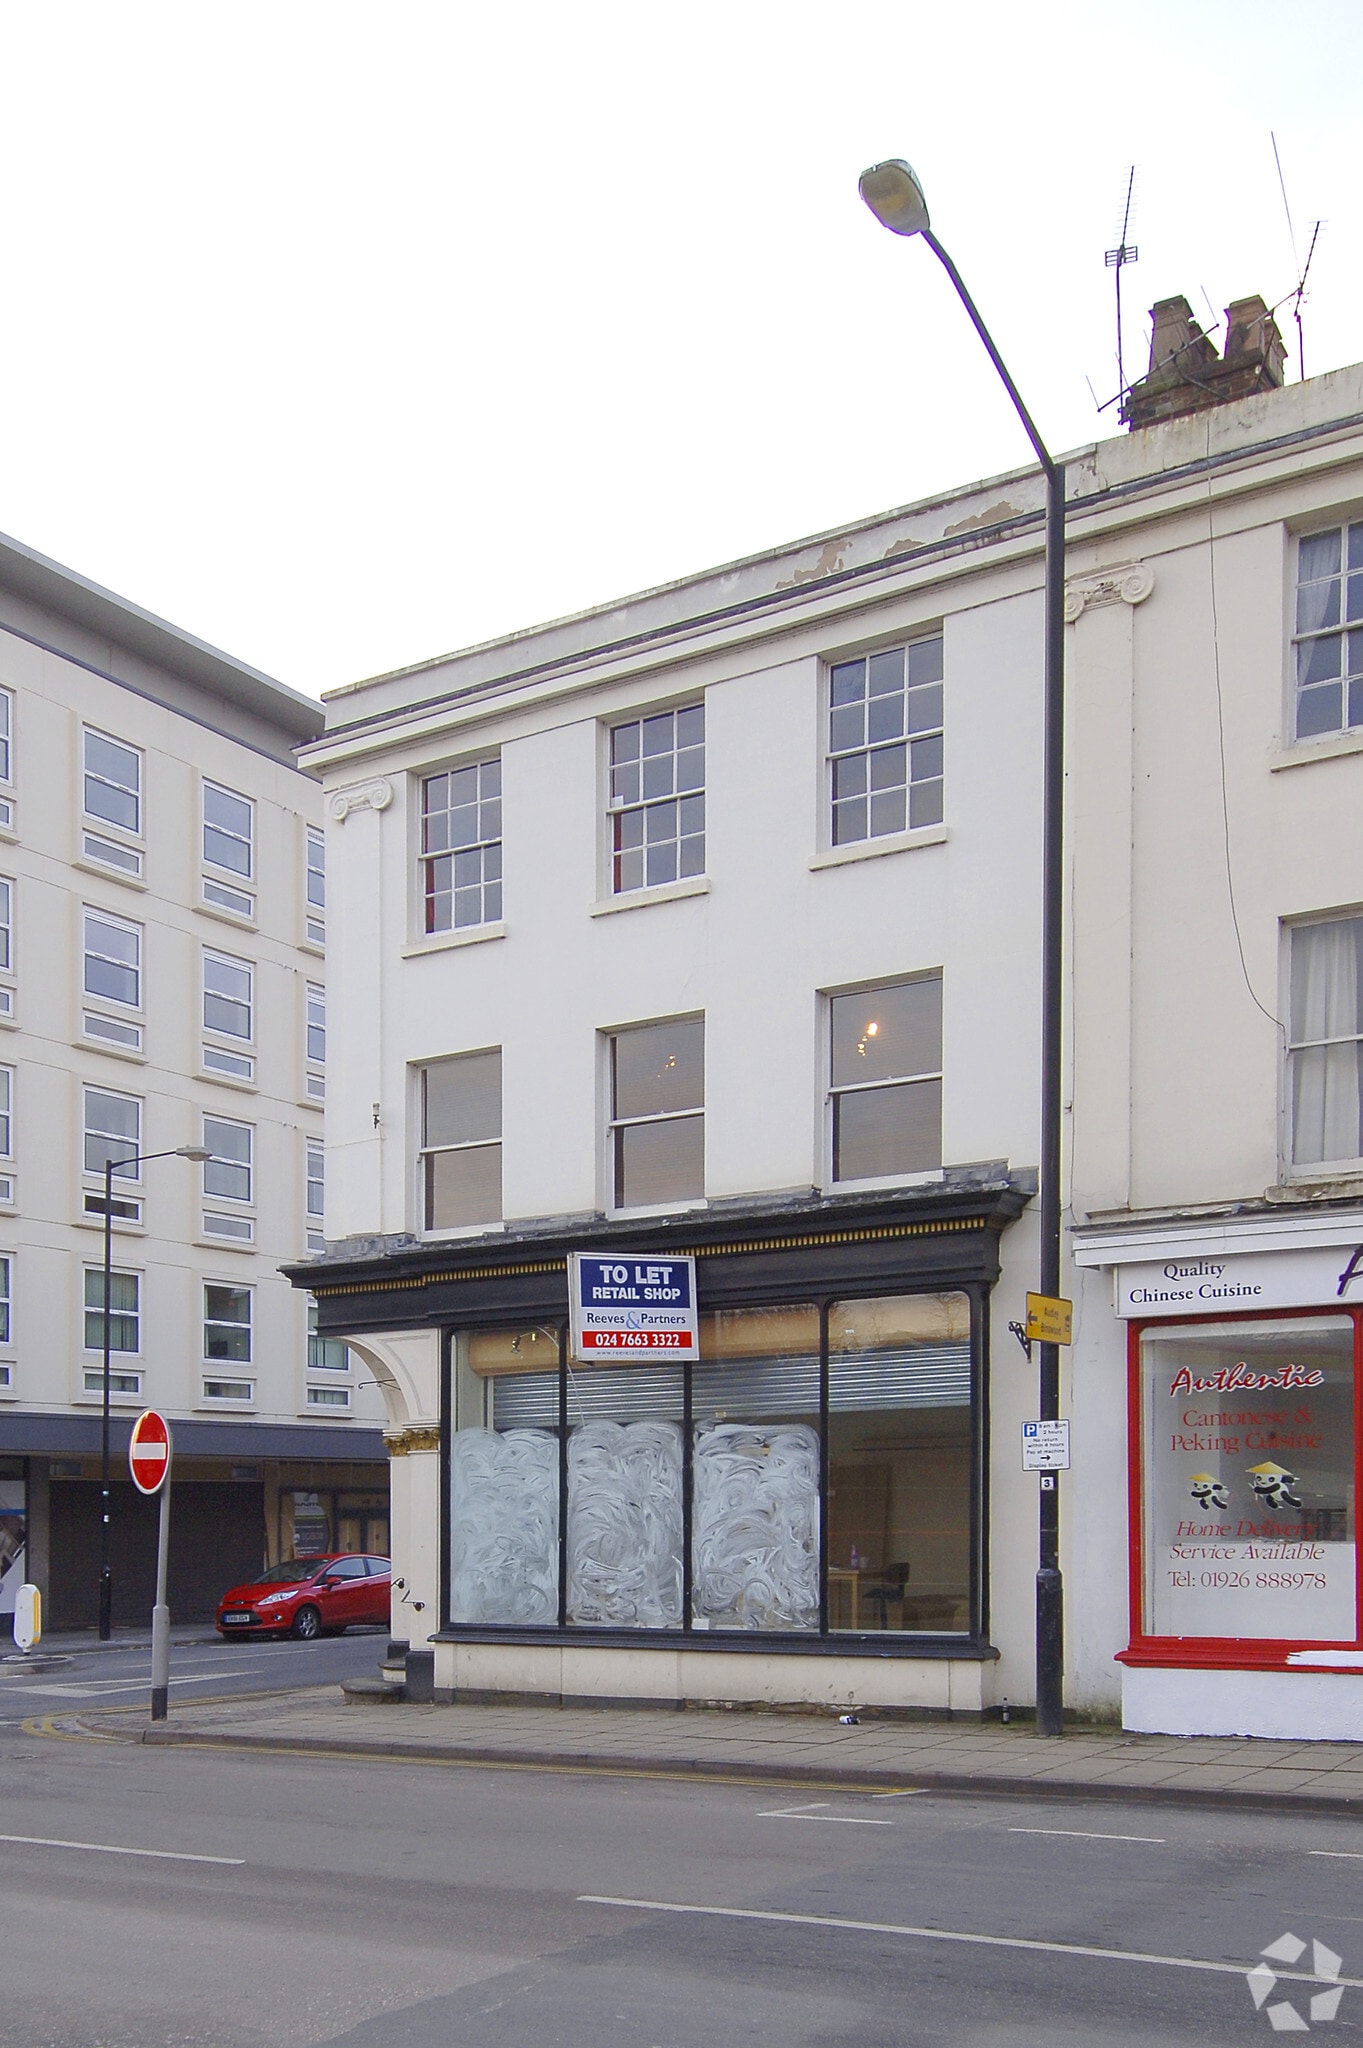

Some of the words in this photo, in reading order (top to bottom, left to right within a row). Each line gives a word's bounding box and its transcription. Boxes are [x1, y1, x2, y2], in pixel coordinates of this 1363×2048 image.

[600, 1265, 628, 1284] TO
[635, 1266, 672, 1284] LET
[1164, 1262, 1226, 1281] Quality
[592, 1287, 640, 1299] RETAIL
[644, 1288, 681, 1300] SHOP
[1130, 1286, 1194, 1304] Chinese
[1198, 1282, 1262, 1299] Cuisine
[586, 1312, 625, 1324] Reeves
[626, 1311, 642, 1329] &
[641, 1313, 686, 1324] Partners
[595, 1334, 617, 1346] 024
[620, 1334, 648, 1346] 7663
[652, 1334, 680, 1346] 3322
[1170, 1362, 1324, 1397] Authentic
[1183, 1408, 1290, 1427] Cantonese
[1294, 1406, 1312, 1424] &
[1026, 1425, 1036, 1437] P
[1170, 1433, 1239, 1455] Peking
[1245, 1431, 1324, 1450] Cuisine
[1044, 1479, 1050, 1488] 3
[1176, 1521, 1231, 1537] Home
[1236, 1520, 1318, 1541] Delivery
[1170, 1544, 1235, 1560] Service
[1241, 1544, 1324, 1560] Available
[1168, 1571, 1195, 1587] Tel:
[1200, 1572, 1250, 1588] 01926
[1255, 1572, 1326, 1590] 888978
